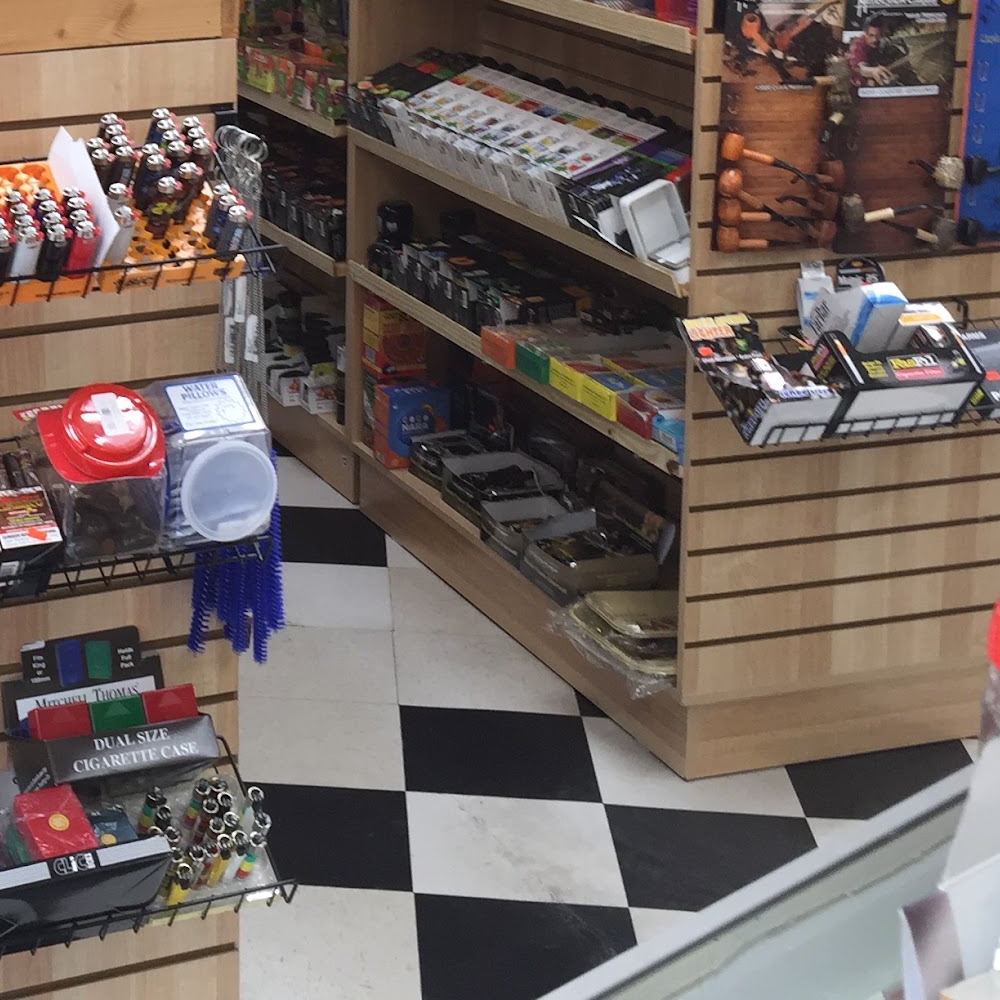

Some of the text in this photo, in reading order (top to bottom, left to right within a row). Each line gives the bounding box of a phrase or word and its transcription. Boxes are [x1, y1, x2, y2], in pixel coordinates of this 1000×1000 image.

[181, 381, 219, 393] WATER
[92, 684, 140, 702] THOMAS
[93, 727, 171, 752] DUAL SIZE
[73, 742, 200, 774] CIGARETTE CASE
